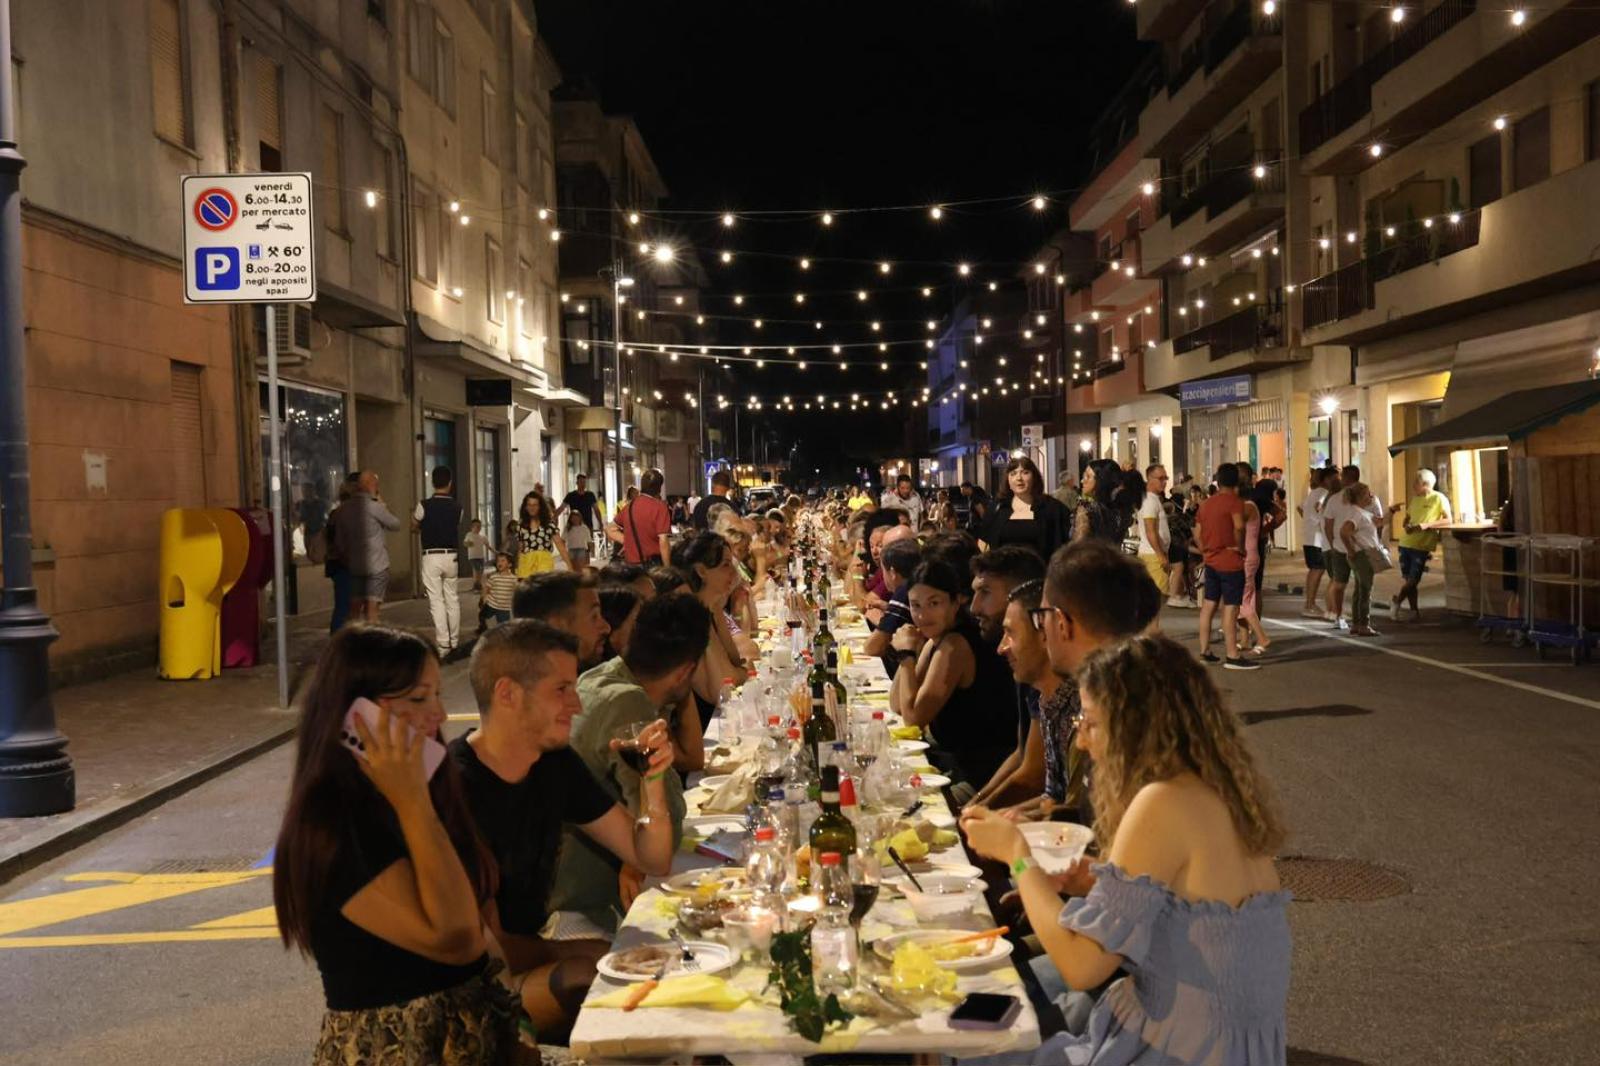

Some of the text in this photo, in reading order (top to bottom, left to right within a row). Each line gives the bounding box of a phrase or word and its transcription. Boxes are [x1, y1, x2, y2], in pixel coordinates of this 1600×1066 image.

[245, 193, 302, 204] 6.00-14.30
[242, 209, 259, 218] per
[206, 254, 231, 284] P
[246, 262, 306, 274] 8.00-20.00
[246, 277, 307, 286] negli appositi
